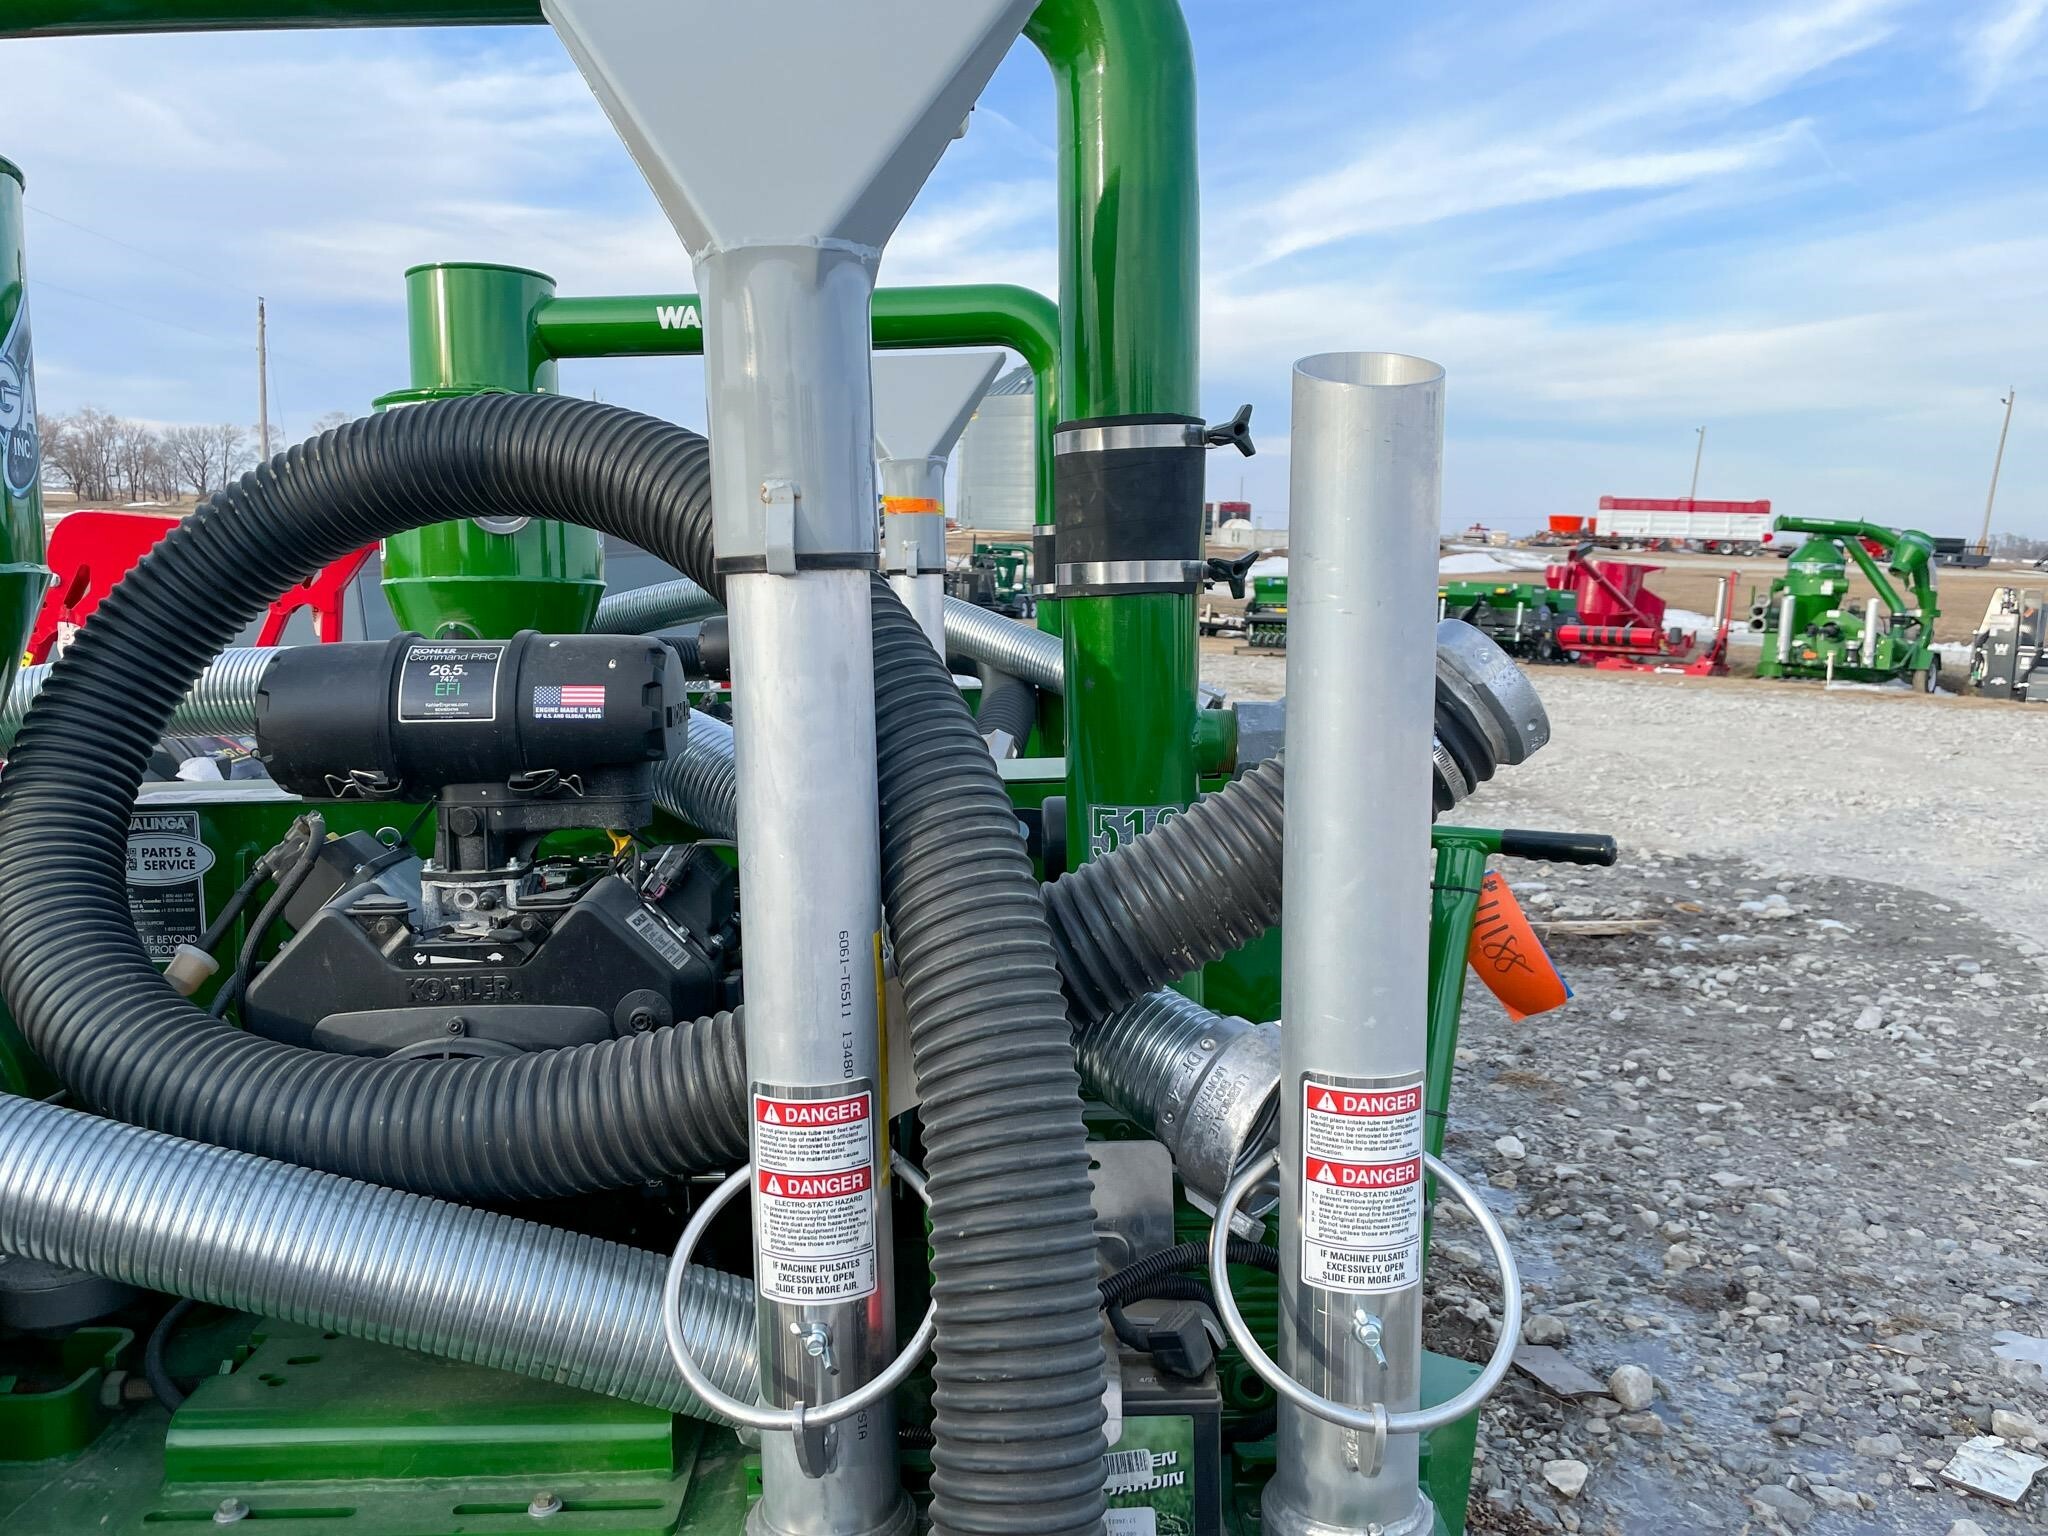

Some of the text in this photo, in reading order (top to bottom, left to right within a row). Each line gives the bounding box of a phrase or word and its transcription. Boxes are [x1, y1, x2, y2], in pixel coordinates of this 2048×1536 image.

[656, 305, 702, 329] WA
[14, 436, 33, 459] INC.
[410, 652, 498, 661] Command PRO
[429, 664, 463, 676] 26.5
[435, 682, 460, 696] EFI
[141, 846, 197, 858] PARTS &
[144, 860, 196, 871] SERVICE
[157, 934, 198, 944] BEYOND
[150, 945, 180, 955] PROD
[839, 930, 852, 1019] 6061-T6511
[405, 976, 511, 1001] KOHLER
[842, 1031, 854, 1079] 13480
[1193, 1065, 1229, 1122] MONTHLY
[1204, 1080, 1232, 1122] BOLTS
[1343, 1093, 1416, 1113] DANGER
[785, 1102, 861, 1123] DANGER
[1310, 1120, 1334, 1129] standing
[1330, 1117, 1346, 1125] place
[833, 1131, 858, 1140] Sufficient
[1310, 1126, 1332, 1135] material
[1310, 1138, 1344, 1150] Submersion
[1399, 1142, 1413, 1150] cause
[1310, 1144, 1343, 1156] suffocation.
[1342, 1164, 1415, 1185] DANGER
[787, 1173, 863, 1195] DANGER
[1326, 1186, 1414, 1198] ELECTRO-STATIC HAZARD
[775, 1195, 863, 1208] ELECTRO-STATIC HAZARD
[1320, 1195, 1341, 1203] prevent
[812, 1208, 828, 1216] injury
[1331, 1215, 1355, 1223] Original
[1319, 1226, 1336, 1235] piping,
[1389, 1227, 1409, 1236] properly
[1319, 1233, 1347, 1241] grounded.
[1320, 1249, 1328, 1258] IF
[1330, 1251, 1370, 1263] MACHINE
[1372, 1249, 1408, 1263] PULSATES
[772, 1260, 778, 1269] IF
[780, 1262, 817, 1273] MACHINE
[820, 1258, 860, 1272] PULSATES
[1326, 1261, 1382, 1274] EXCESSIVELY,
[1384, 1261, 1404, 1273] OPEN
[778, 1271, 855, 1284] EXCESSIVELY, OPEN
[1322, 1271, 1346, 1283] SLIDE
[1348, 1275, 1365, 1284] FOR
[1367, 1274, 1391, 1284] MORE
[1393, 1272, 1407, 1282] AIR.
[775, 1283, 795, 1294] SLIDE
[798, 1286, 814, 1295] FOR
[816, 1284, 840, 1295] MORE
[843, 1281, 859, 1291] AIR.
[857, 1410, 868, 1441] SIA
